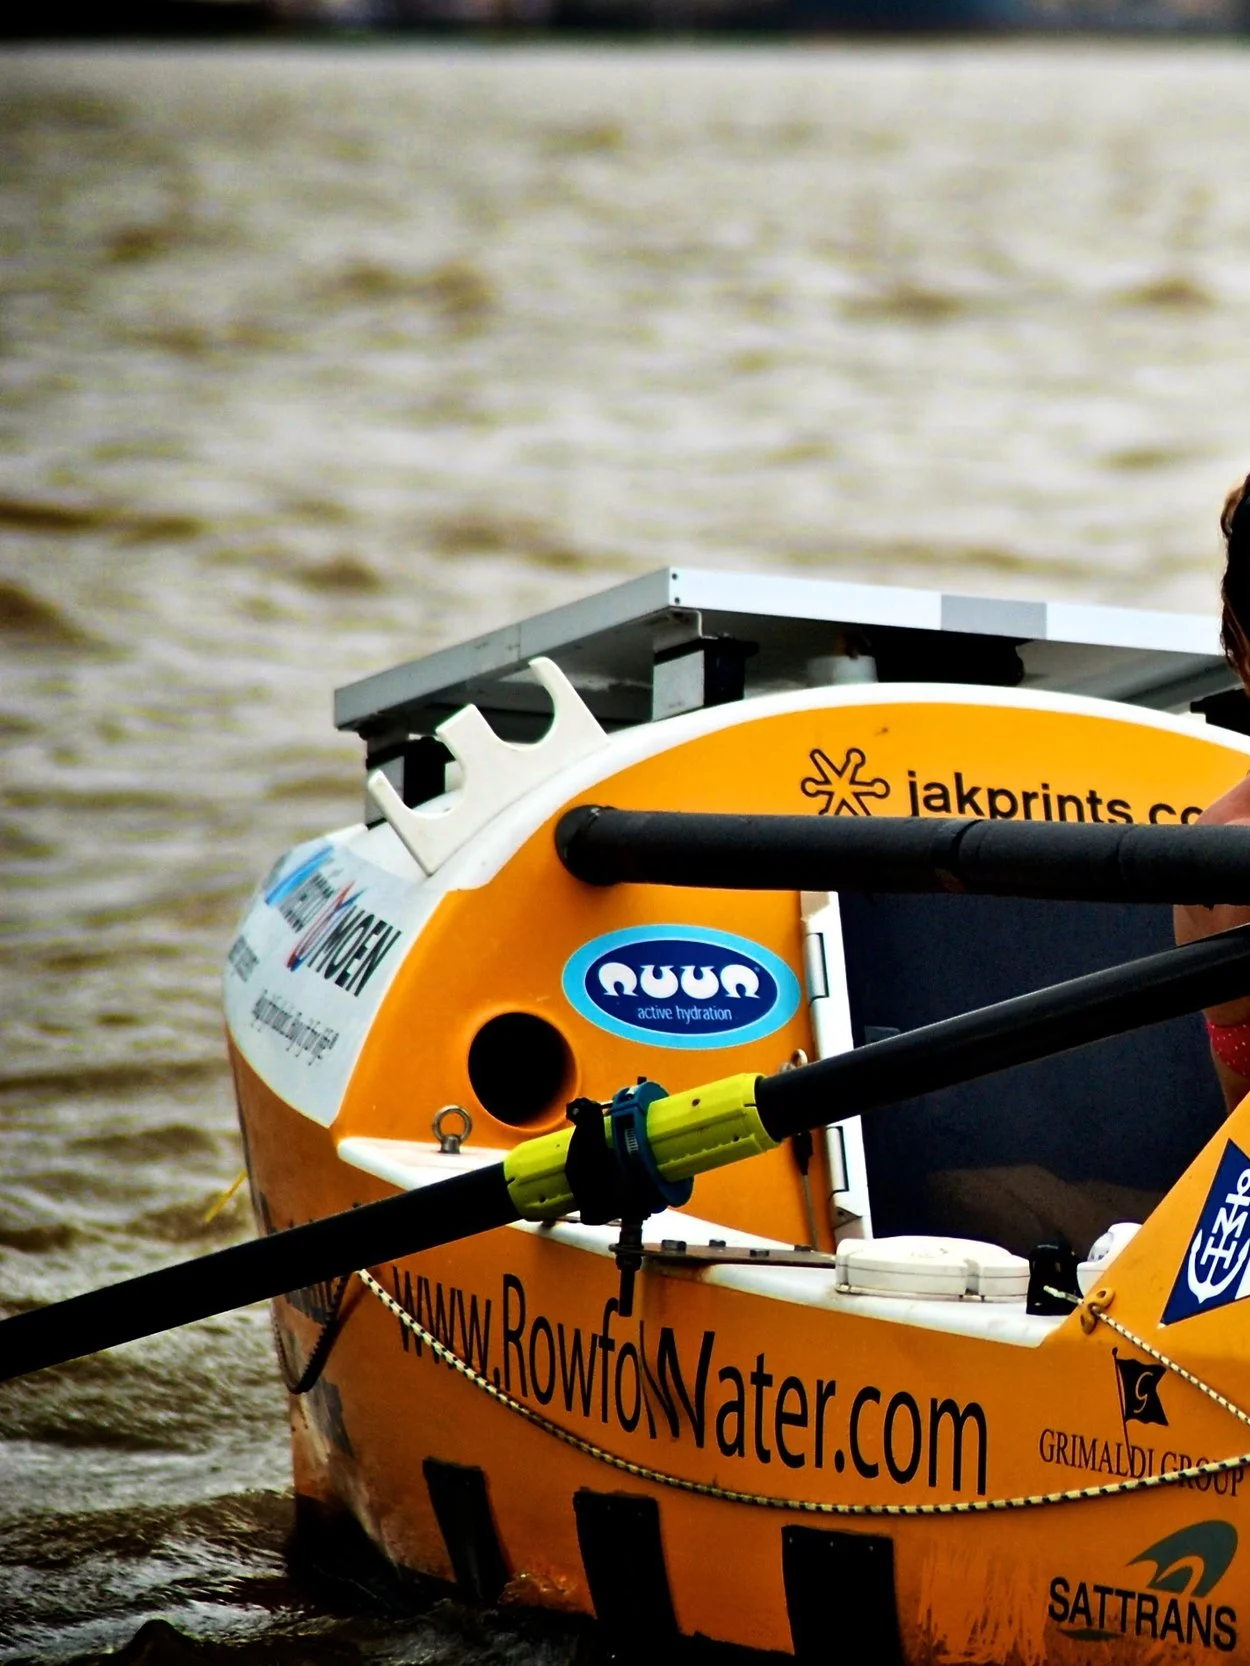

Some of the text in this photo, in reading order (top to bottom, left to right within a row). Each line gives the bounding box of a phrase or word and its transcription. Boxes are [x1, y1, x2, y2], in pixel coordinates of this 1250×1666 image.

[637, 1004, 733, 1025] active hydration
[1038, 1428, 1156, 1480] GRIMALDI
[1047, 1576, 1238, 1653] SATTRANS
